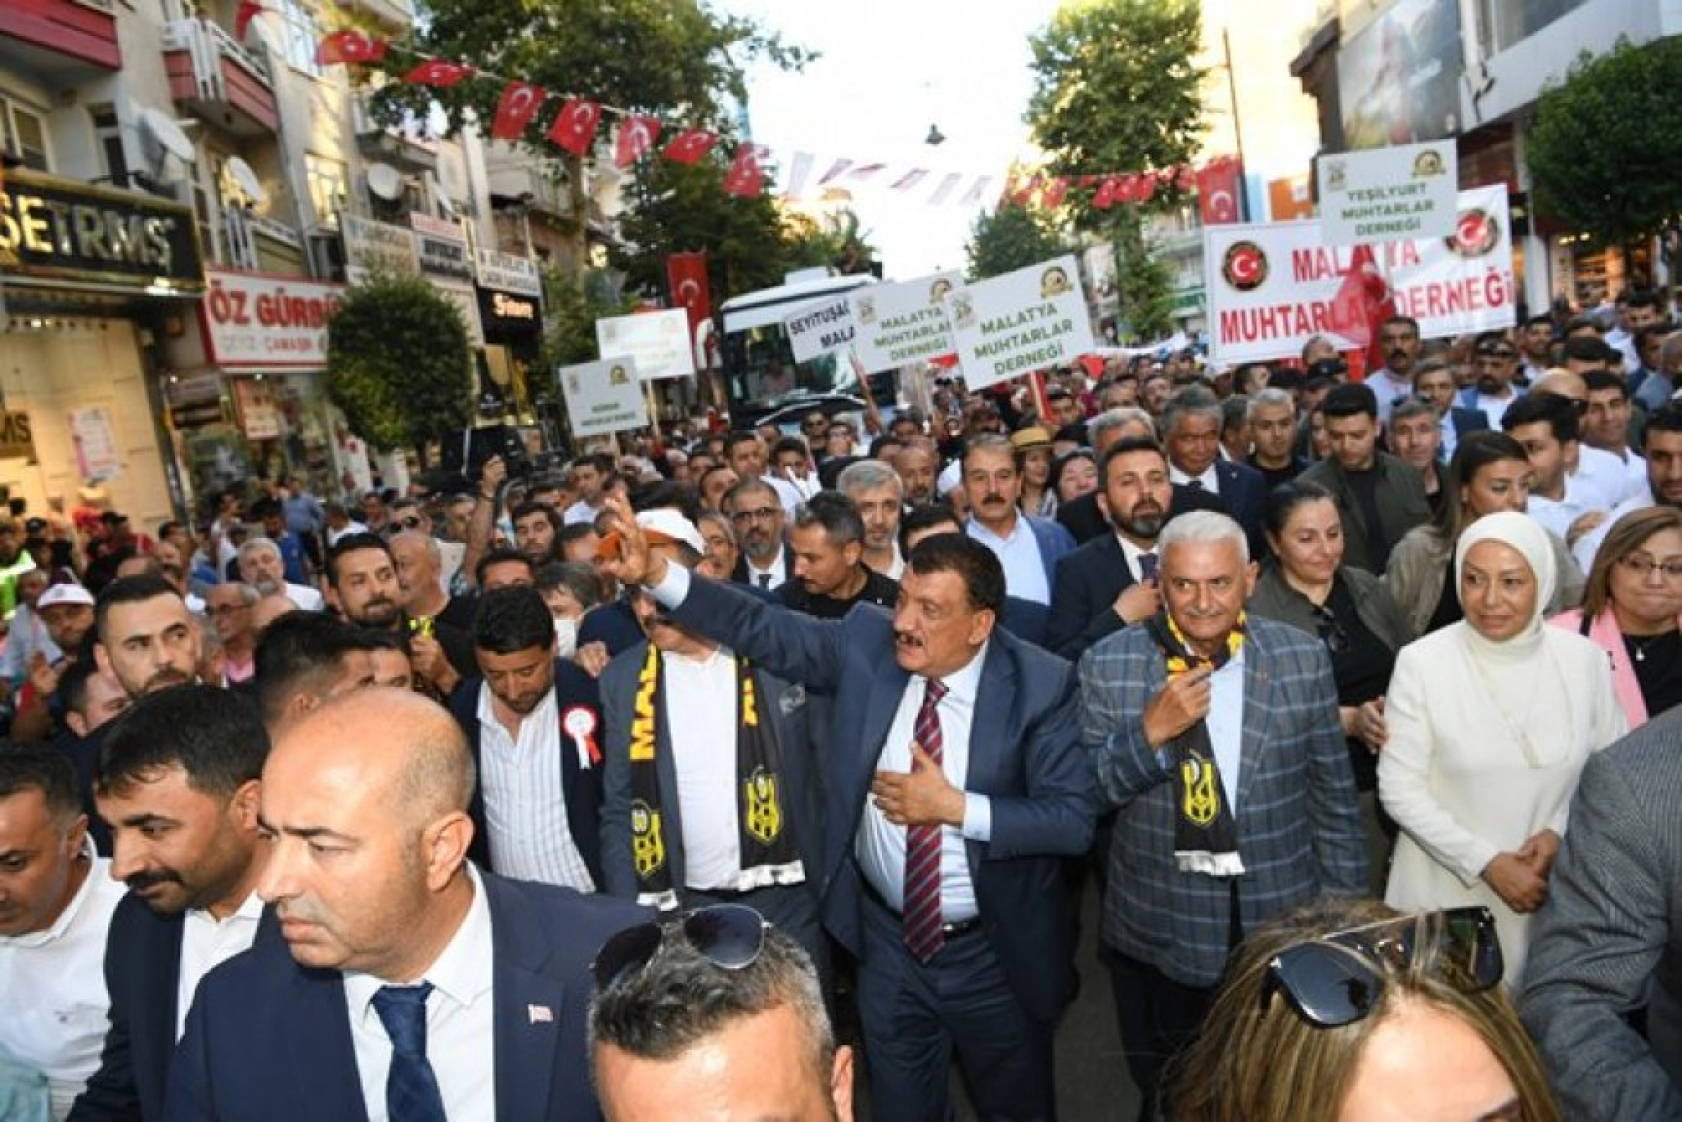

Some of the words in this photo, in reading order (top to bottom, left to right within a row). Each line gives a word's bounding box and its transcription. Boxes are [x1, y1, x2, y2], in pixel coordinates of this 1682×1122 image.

[1342, 200, 1432, 219] MUHTARLAR
[1355, 216, 1420, 235] DERNEĞİ
[209, 279, 250, 325] ÖZ
[881, 306, 941, 328] MALATYA
[980, 302, 1057, 335] MALATYA
[974, 319, 1072, 359] MUHTARLAR
[994, 340, 1063, 374] DERNEĞİ
